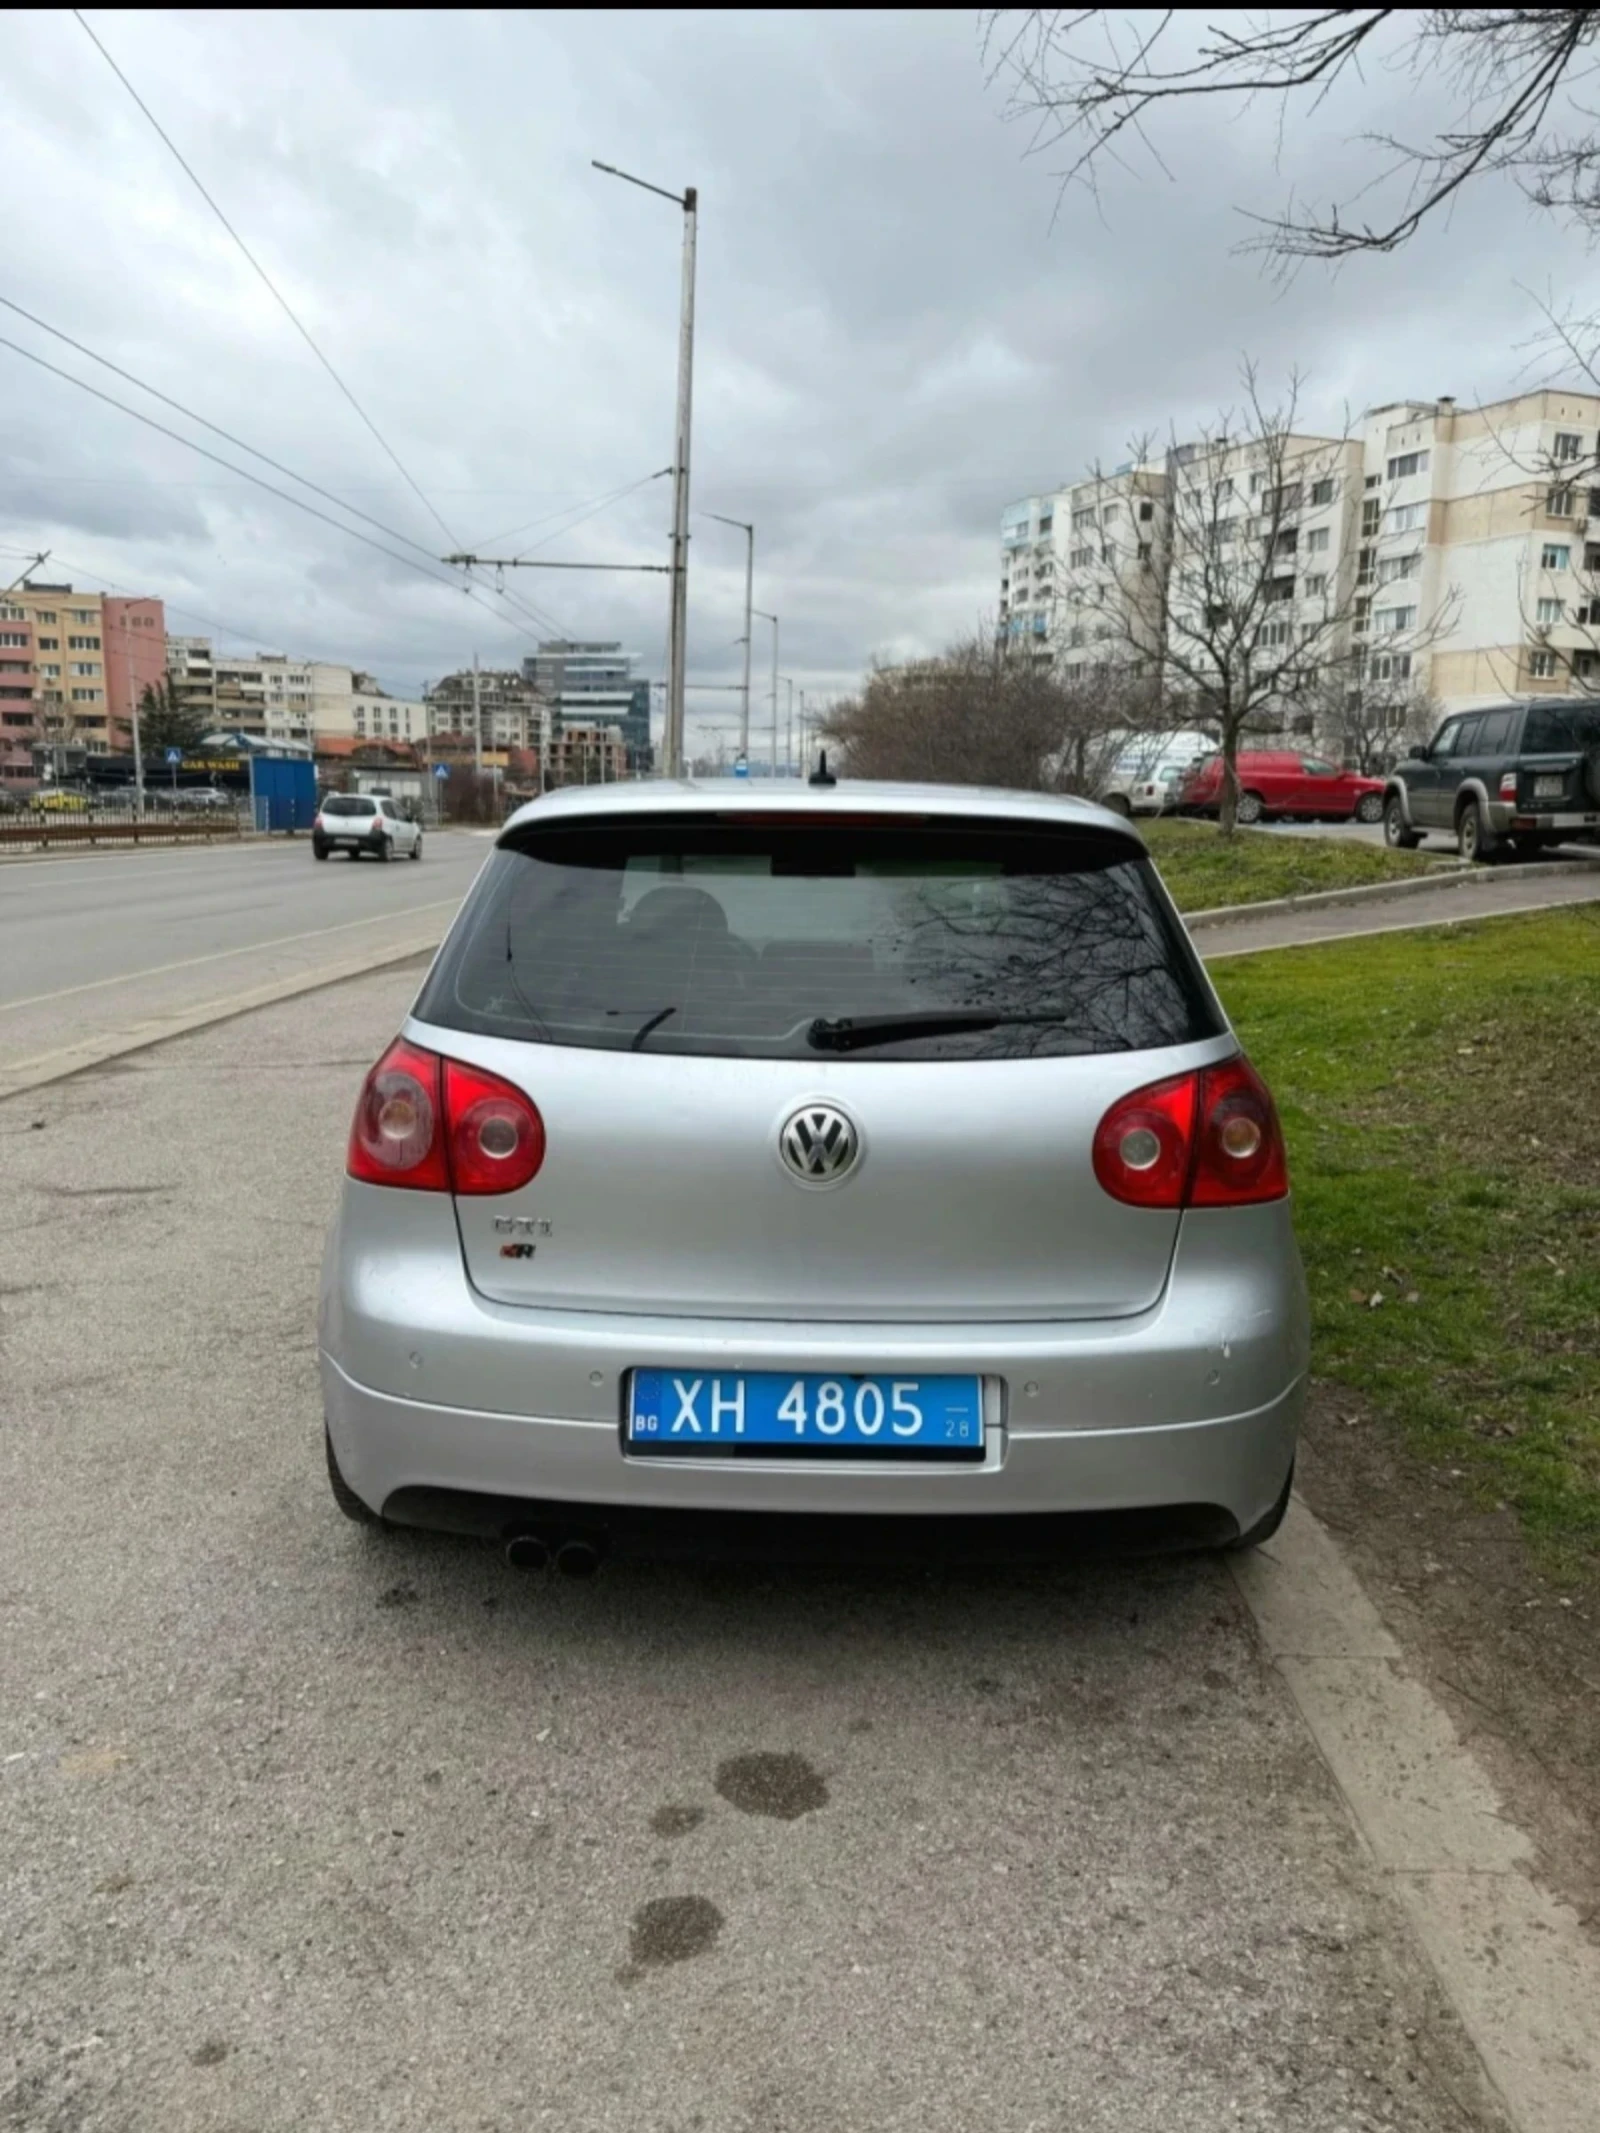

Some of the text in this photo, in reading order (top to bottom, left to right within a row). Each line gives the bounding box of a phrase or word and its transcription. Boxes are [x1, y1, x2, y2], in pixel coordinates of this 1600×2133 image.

[181, 760, 240, 770] CAR WASH
[671, 1379, 924, 1435] XH 4805
[635, 1414, 658, 1432] BG
[945, 1419, 969, 1438] 28
